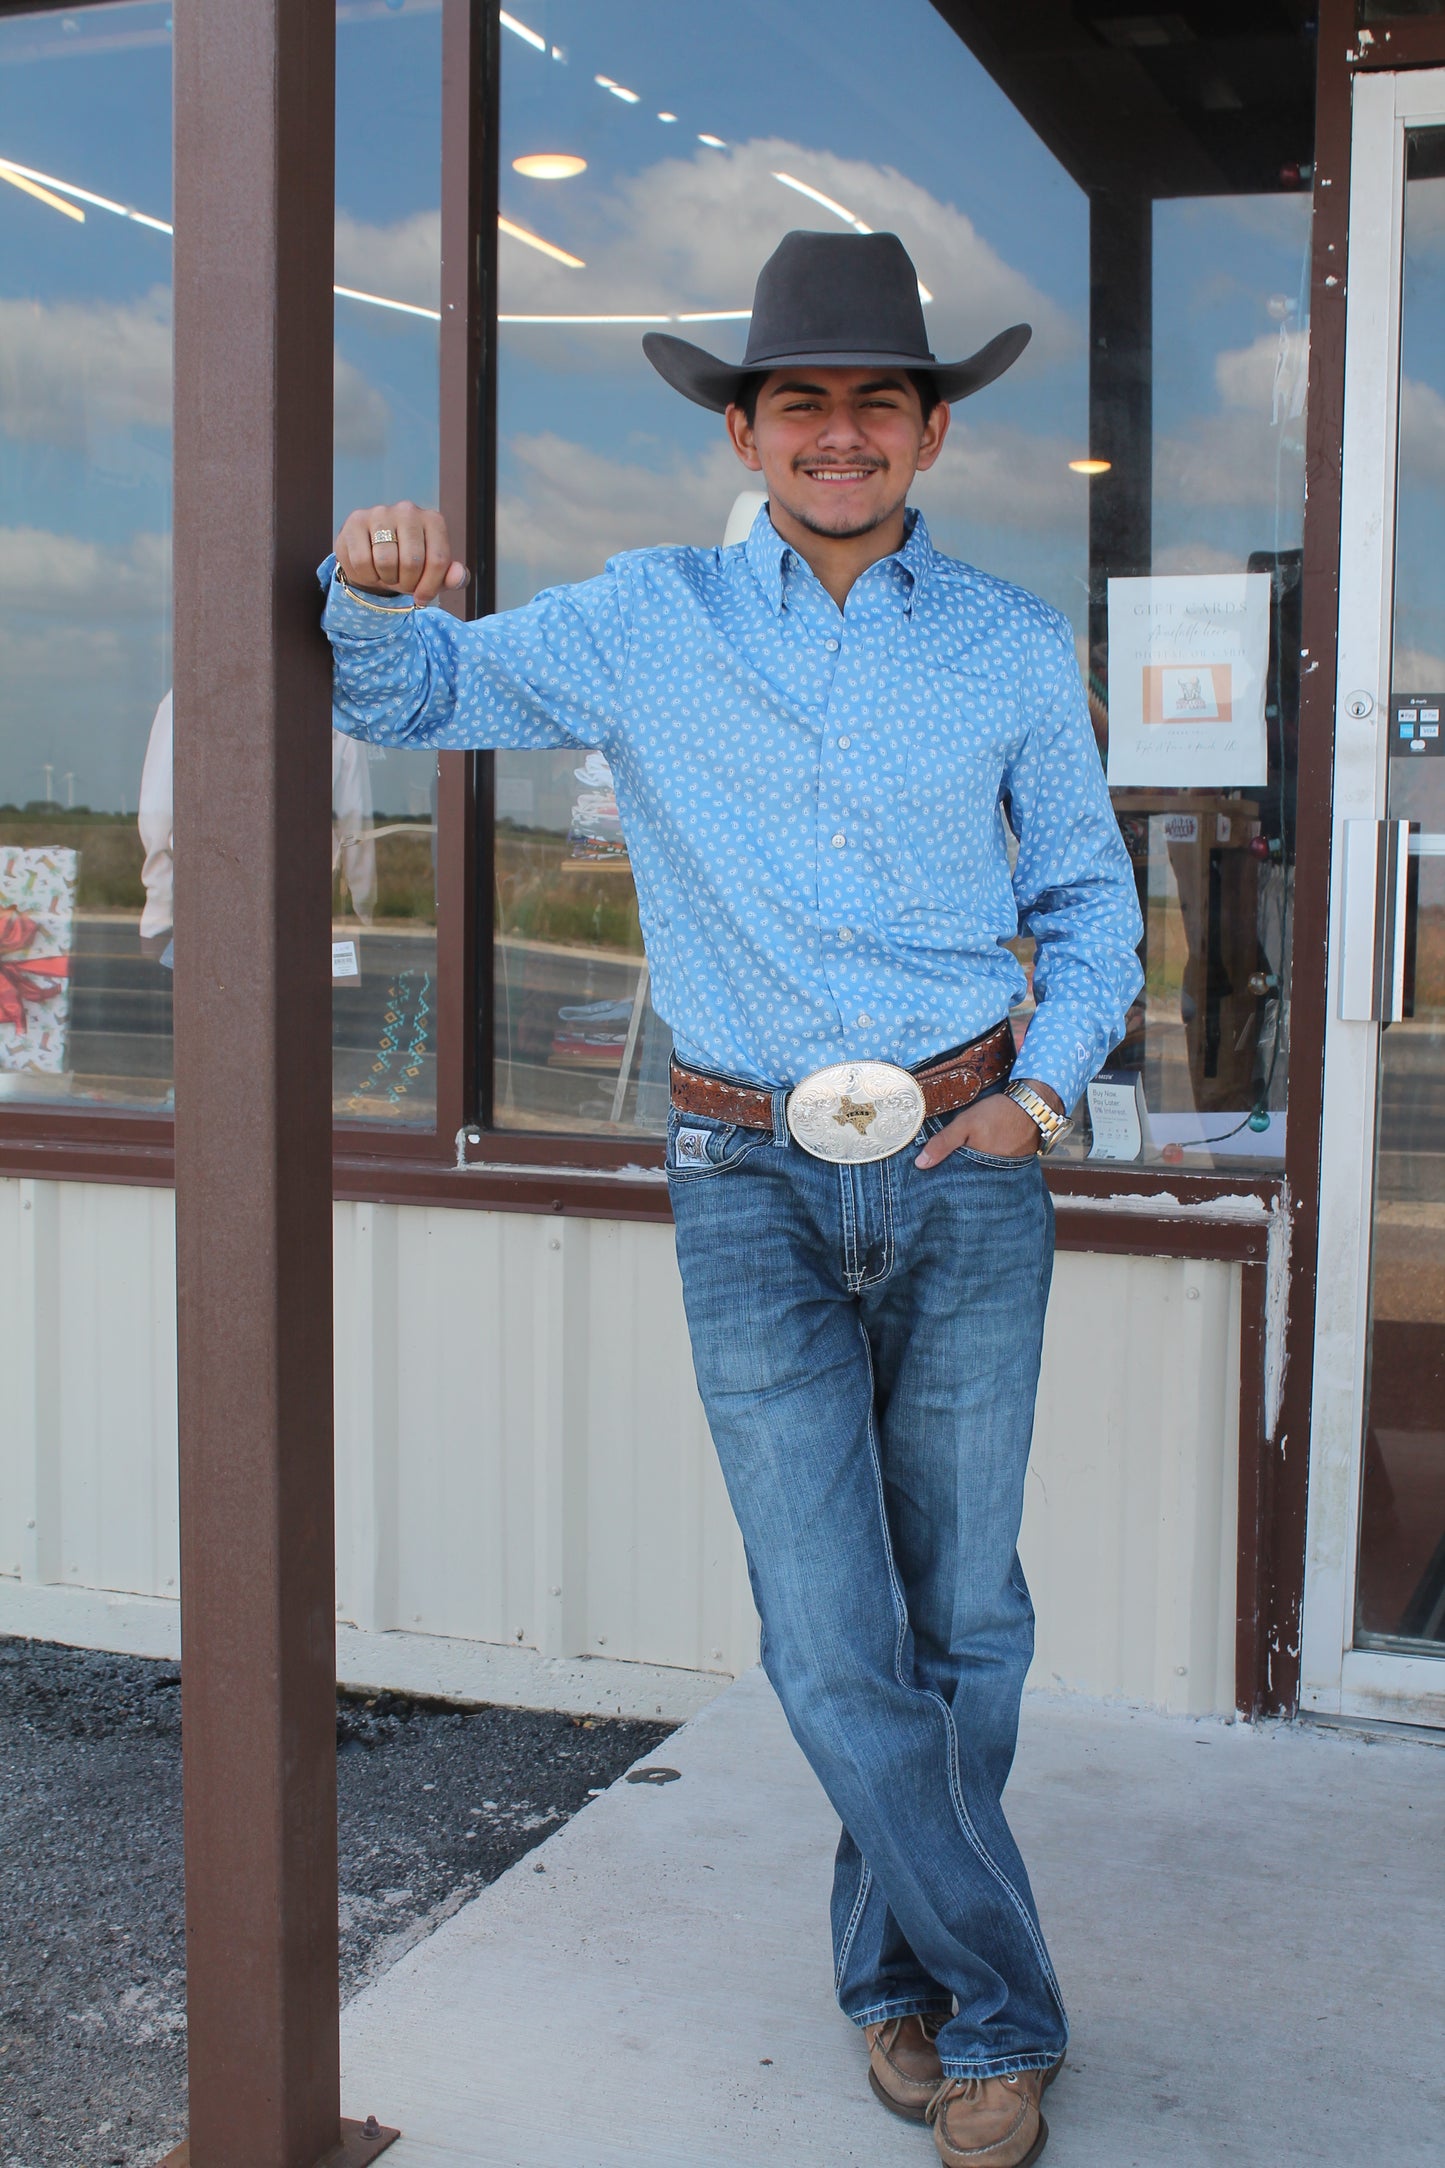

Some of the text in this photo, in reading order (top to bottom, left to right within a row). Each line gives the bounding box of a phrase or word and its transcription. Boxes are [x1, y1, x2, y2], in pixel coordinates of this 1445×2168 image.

[1133, 600, 1248, 616] GIFT CARDS
[1092, 1089, 1103, 1097] Buy
[1093, 1098, 1103, 1106] Pay
